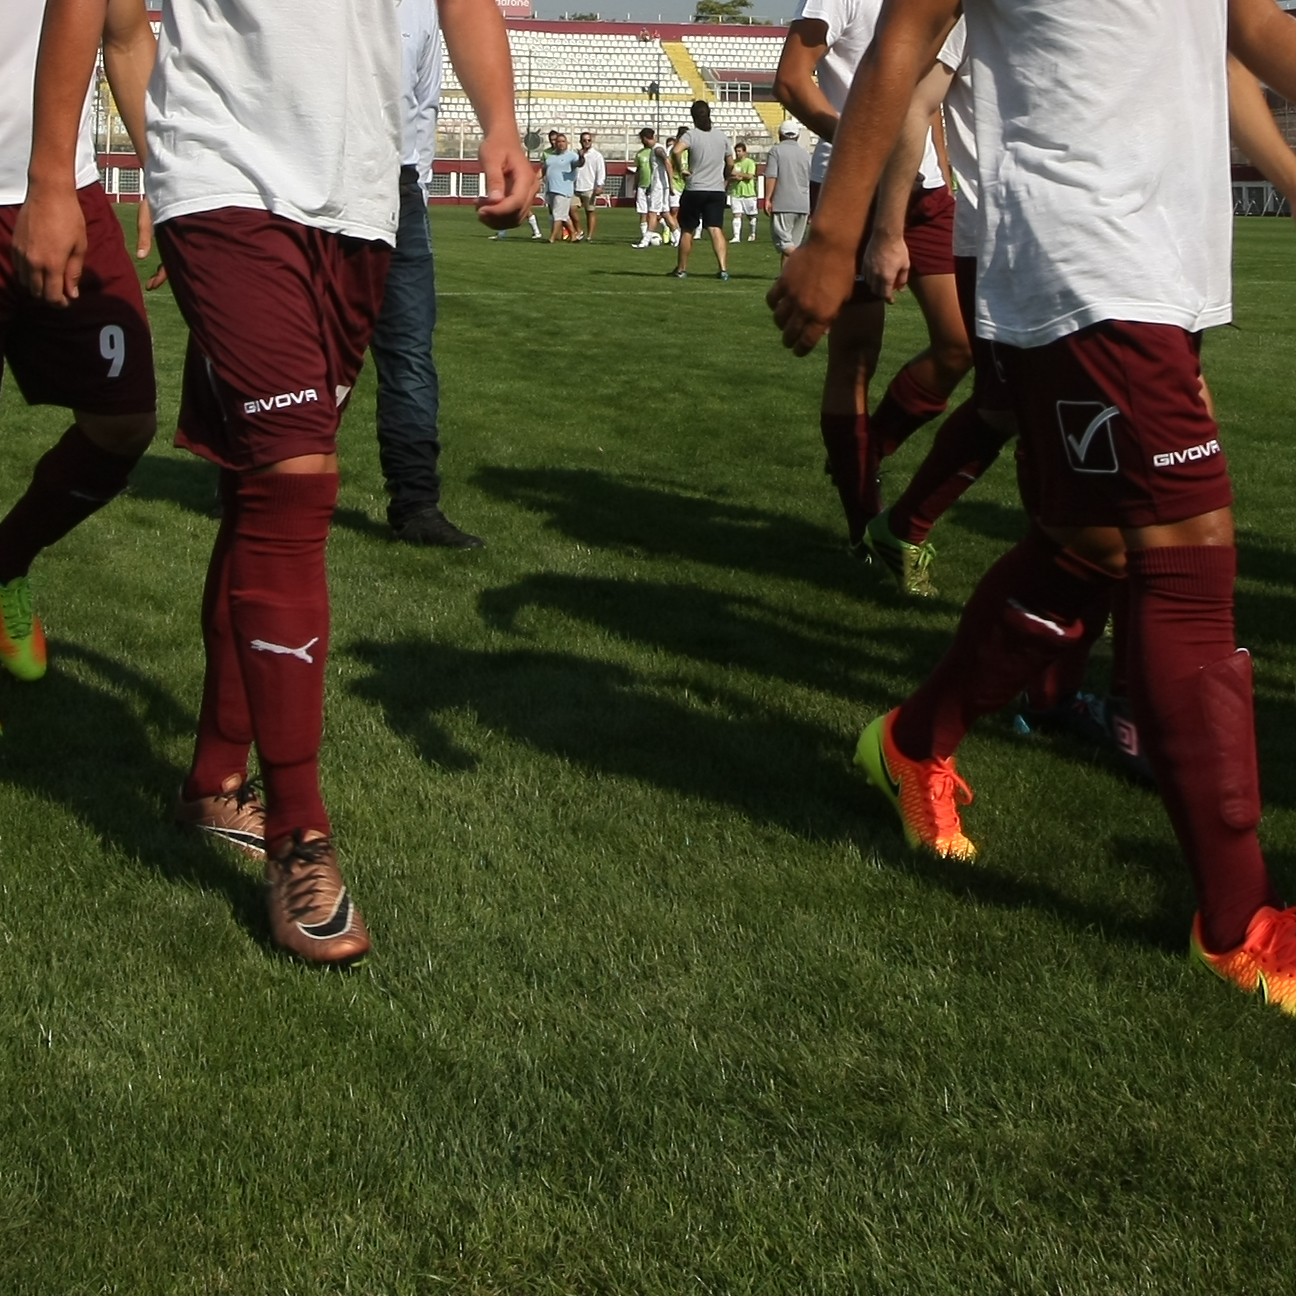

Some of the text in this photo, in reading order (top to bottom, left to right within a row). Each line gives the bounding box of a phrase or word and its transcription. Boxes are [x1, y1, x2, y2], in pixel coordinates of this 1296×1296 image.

[99, 325, 125, 377] 9
[244, 389, 318, 413] GIVOVA
[1153, 439, 1221, 467] GIVOVA
